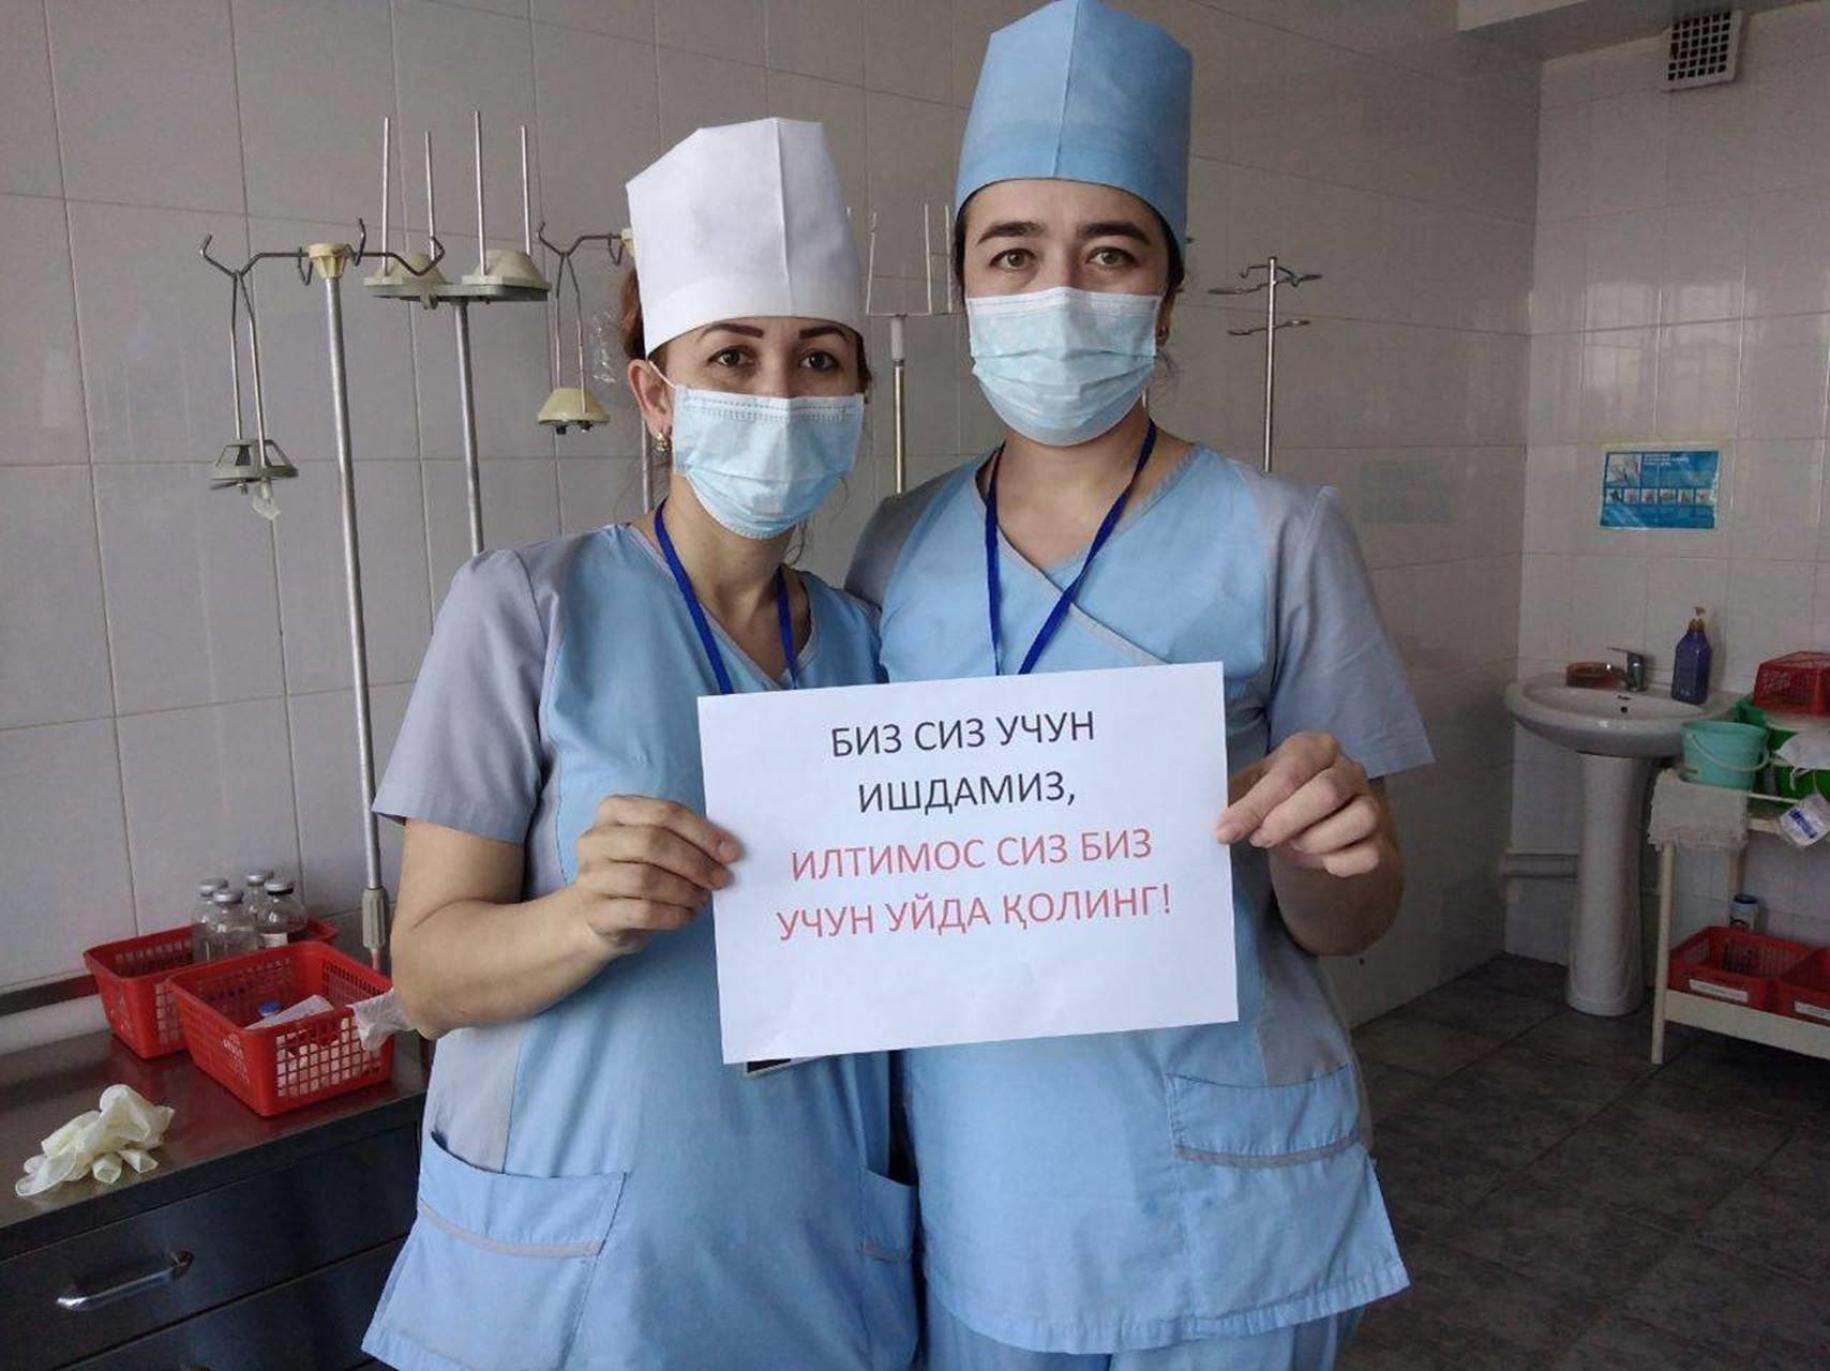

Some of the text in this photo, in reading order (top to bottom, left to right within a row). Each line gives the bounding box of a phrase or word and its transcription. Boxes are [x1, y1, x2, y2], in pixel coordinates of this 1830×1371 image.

[831, 710, 1095, 757] БИЗ СИЗ УЧУН
[858, 772, 1077, 817] ИШДАМИЗ,
[791, 828, 1152, 882] ИЛТИМОС СИЗ БИЗ
[776, 883, 1170, 941] УЧУН УЙДА ҚОЛИНГ!
